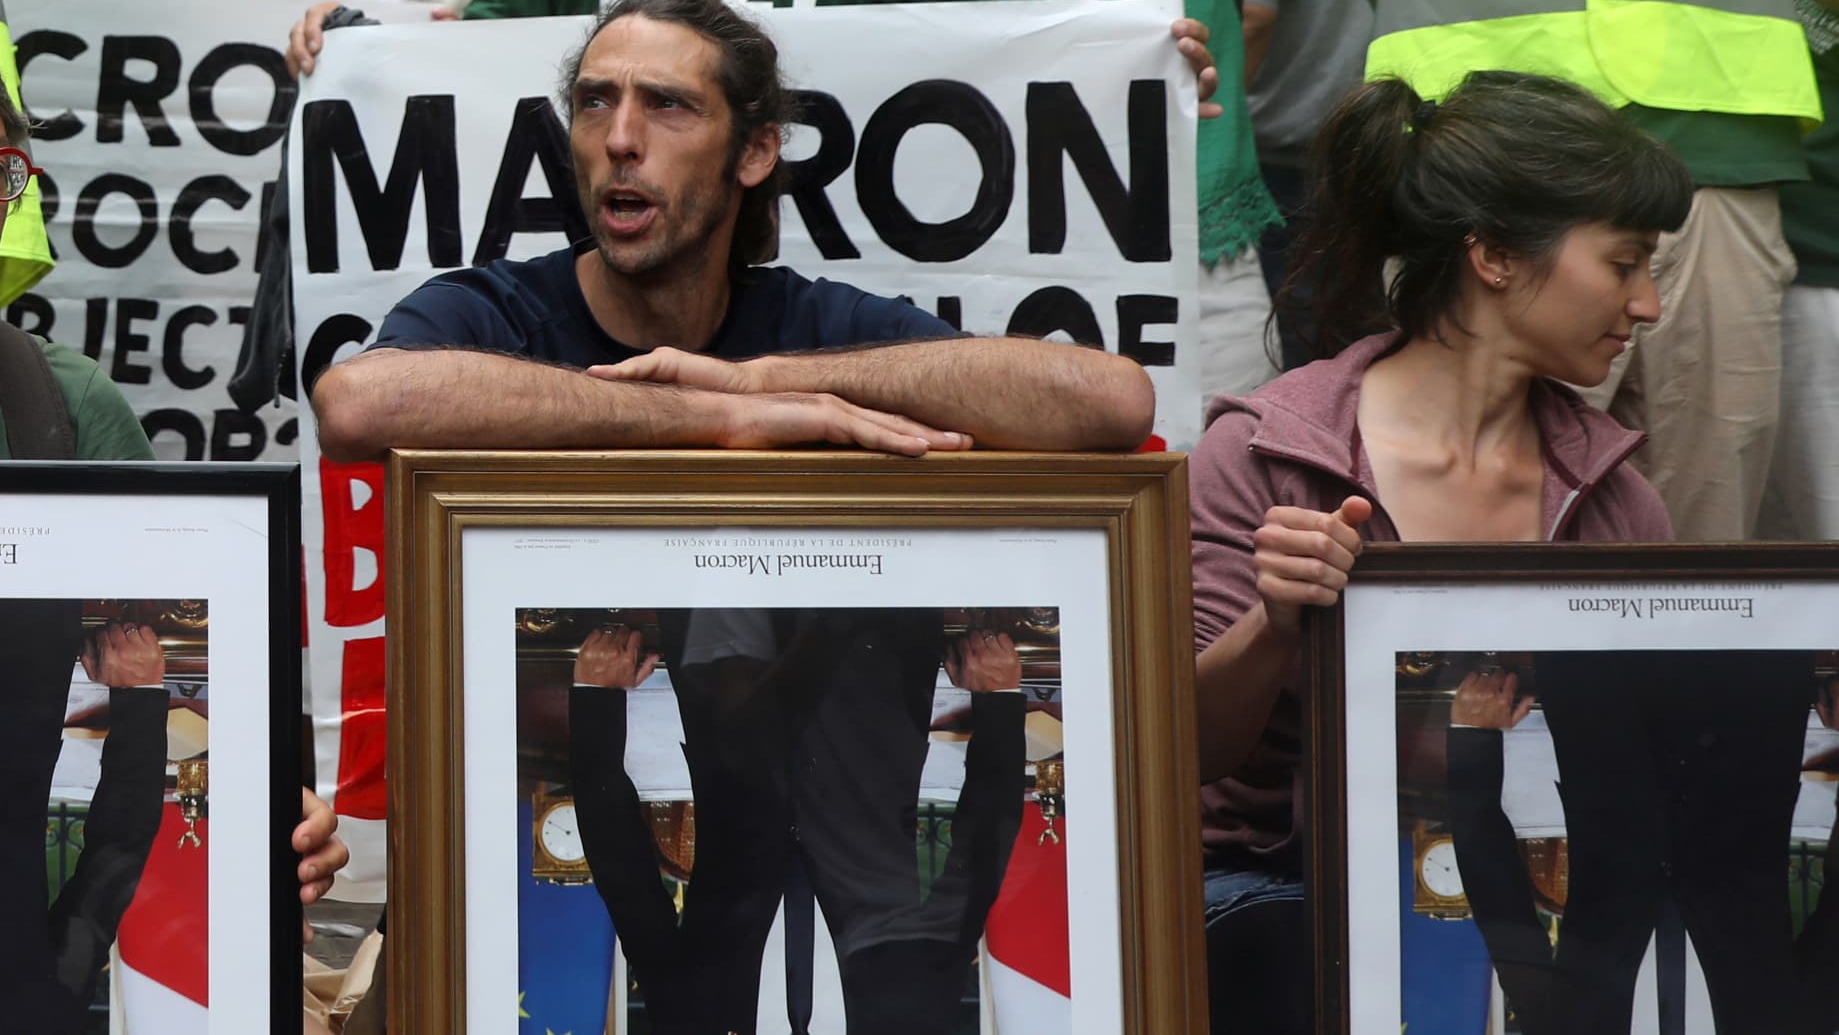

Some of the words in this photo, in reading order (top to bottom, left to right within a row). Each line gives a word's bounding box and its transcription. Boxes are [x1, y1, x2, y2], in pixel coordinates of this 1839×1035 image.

[302, 78, 1173, 275] MARON
[694, 554, 771, 575] Macron
[776, 554, 883, 577] Emmanuel
[1568, 598, 1643, 619] Macron
[1648, 597, 1755, 619] Emmanuel
